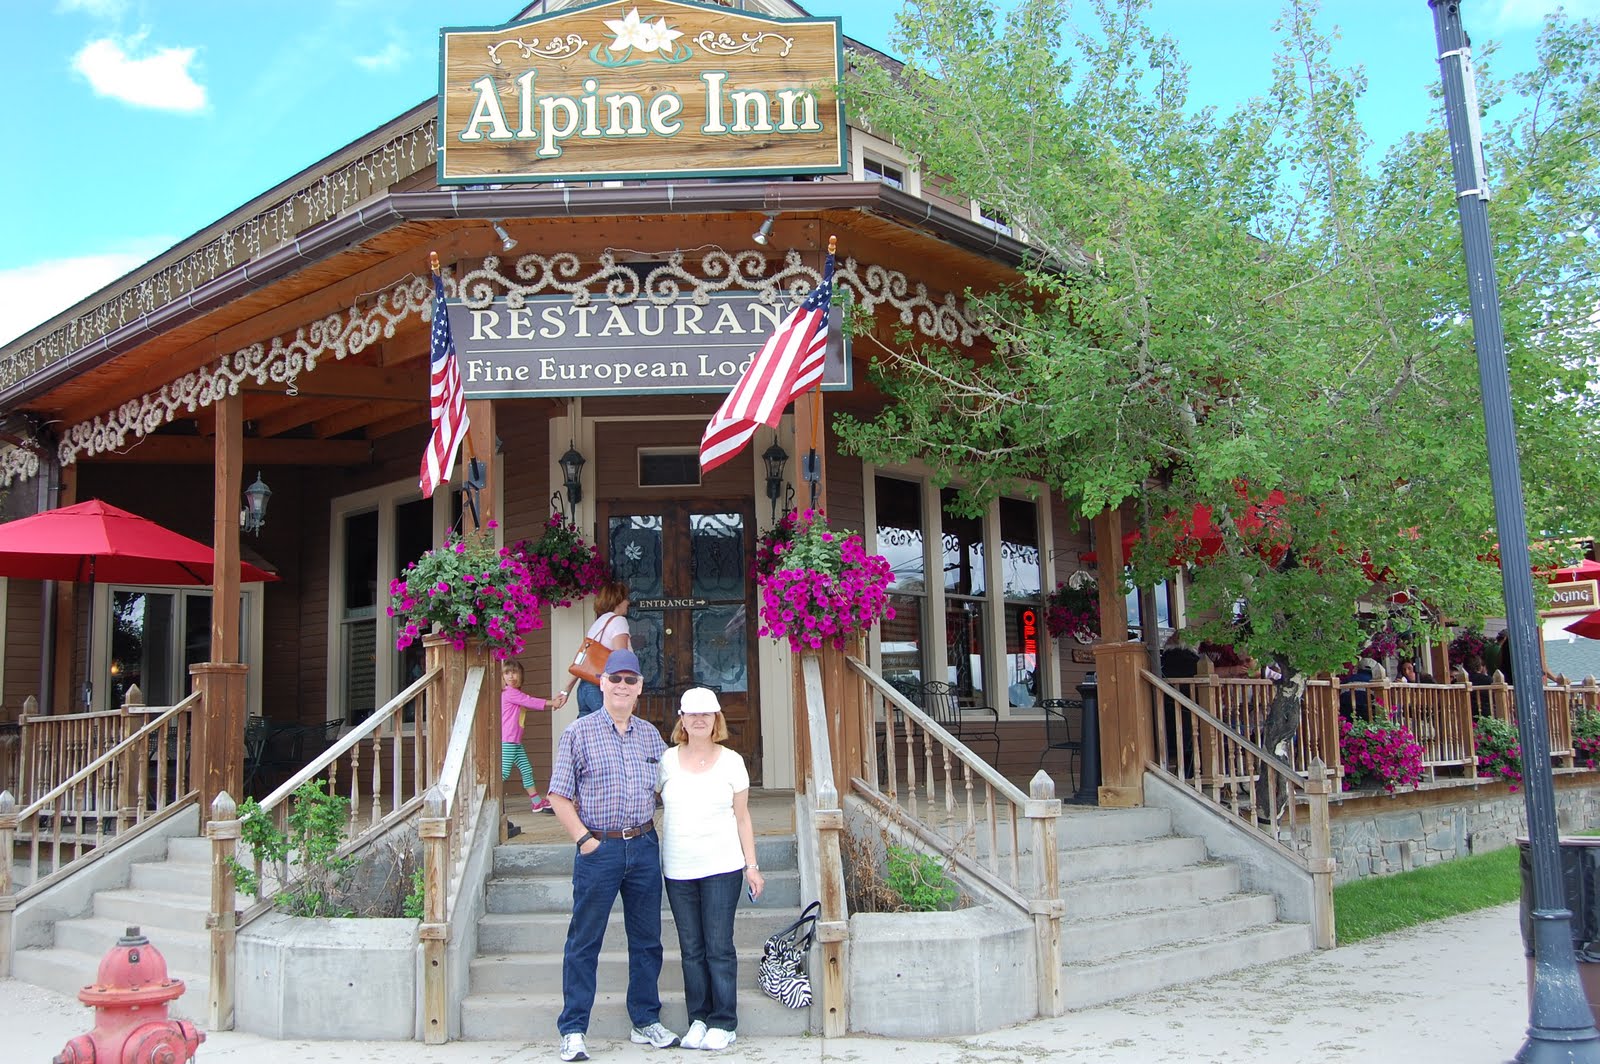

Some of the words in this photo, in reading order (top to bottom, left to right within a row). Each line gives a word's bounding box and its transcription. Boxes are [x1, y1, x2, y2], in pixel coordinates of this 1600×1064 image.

[460, 68, 683, 158] Alpine
[701, 71, 823, 134] Inn
[469, 302, 800, 341] RESTAURAN
[466, 358, 530, 383] Fine
[538, 355, 689, 385] European
[639, 599, 695, 608] ENTRANCE
